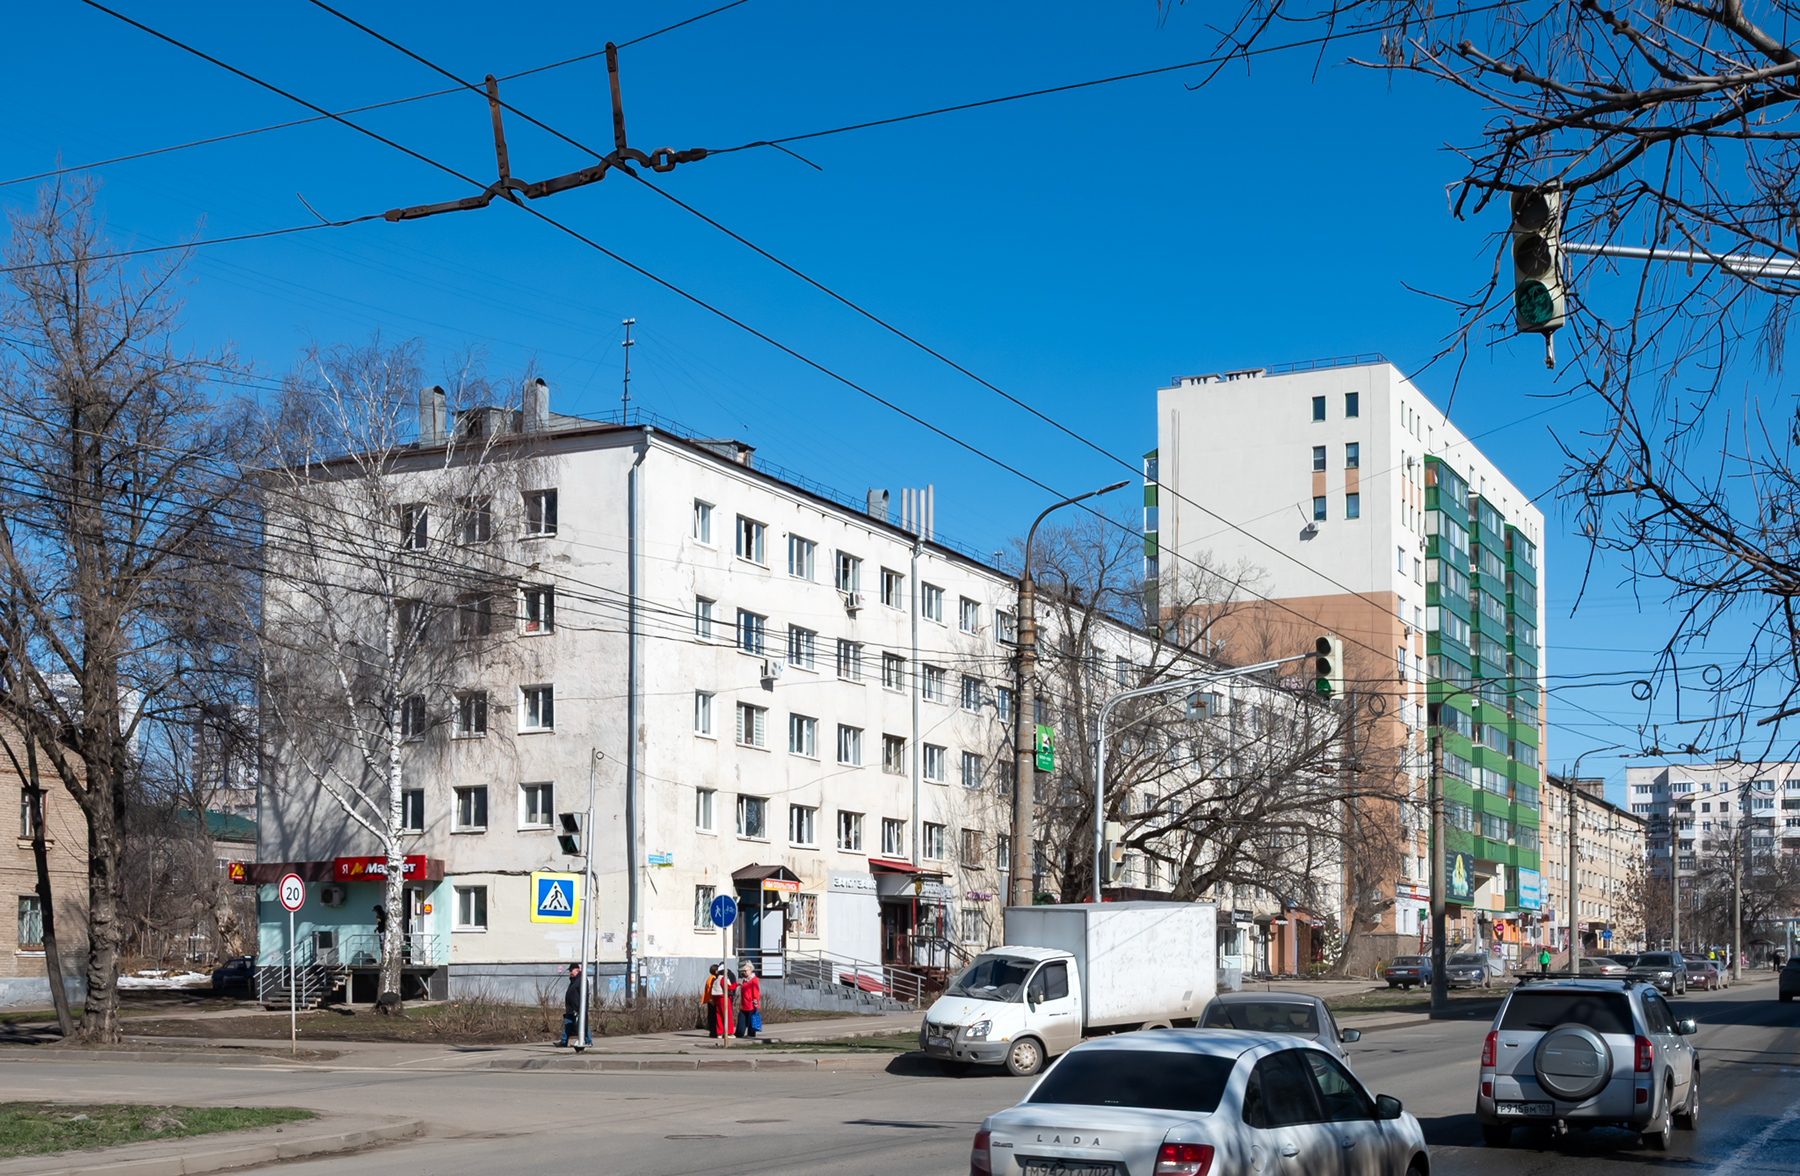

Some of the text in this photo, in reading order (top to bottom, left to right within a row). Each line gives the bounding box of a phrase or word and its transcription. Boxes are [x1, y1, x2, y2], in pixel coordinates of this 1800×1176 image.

[365, 862, 417, 874] Мает
[286, 887, 300, 901] 20
[1036, 1133, 1101, 1146] LADA
